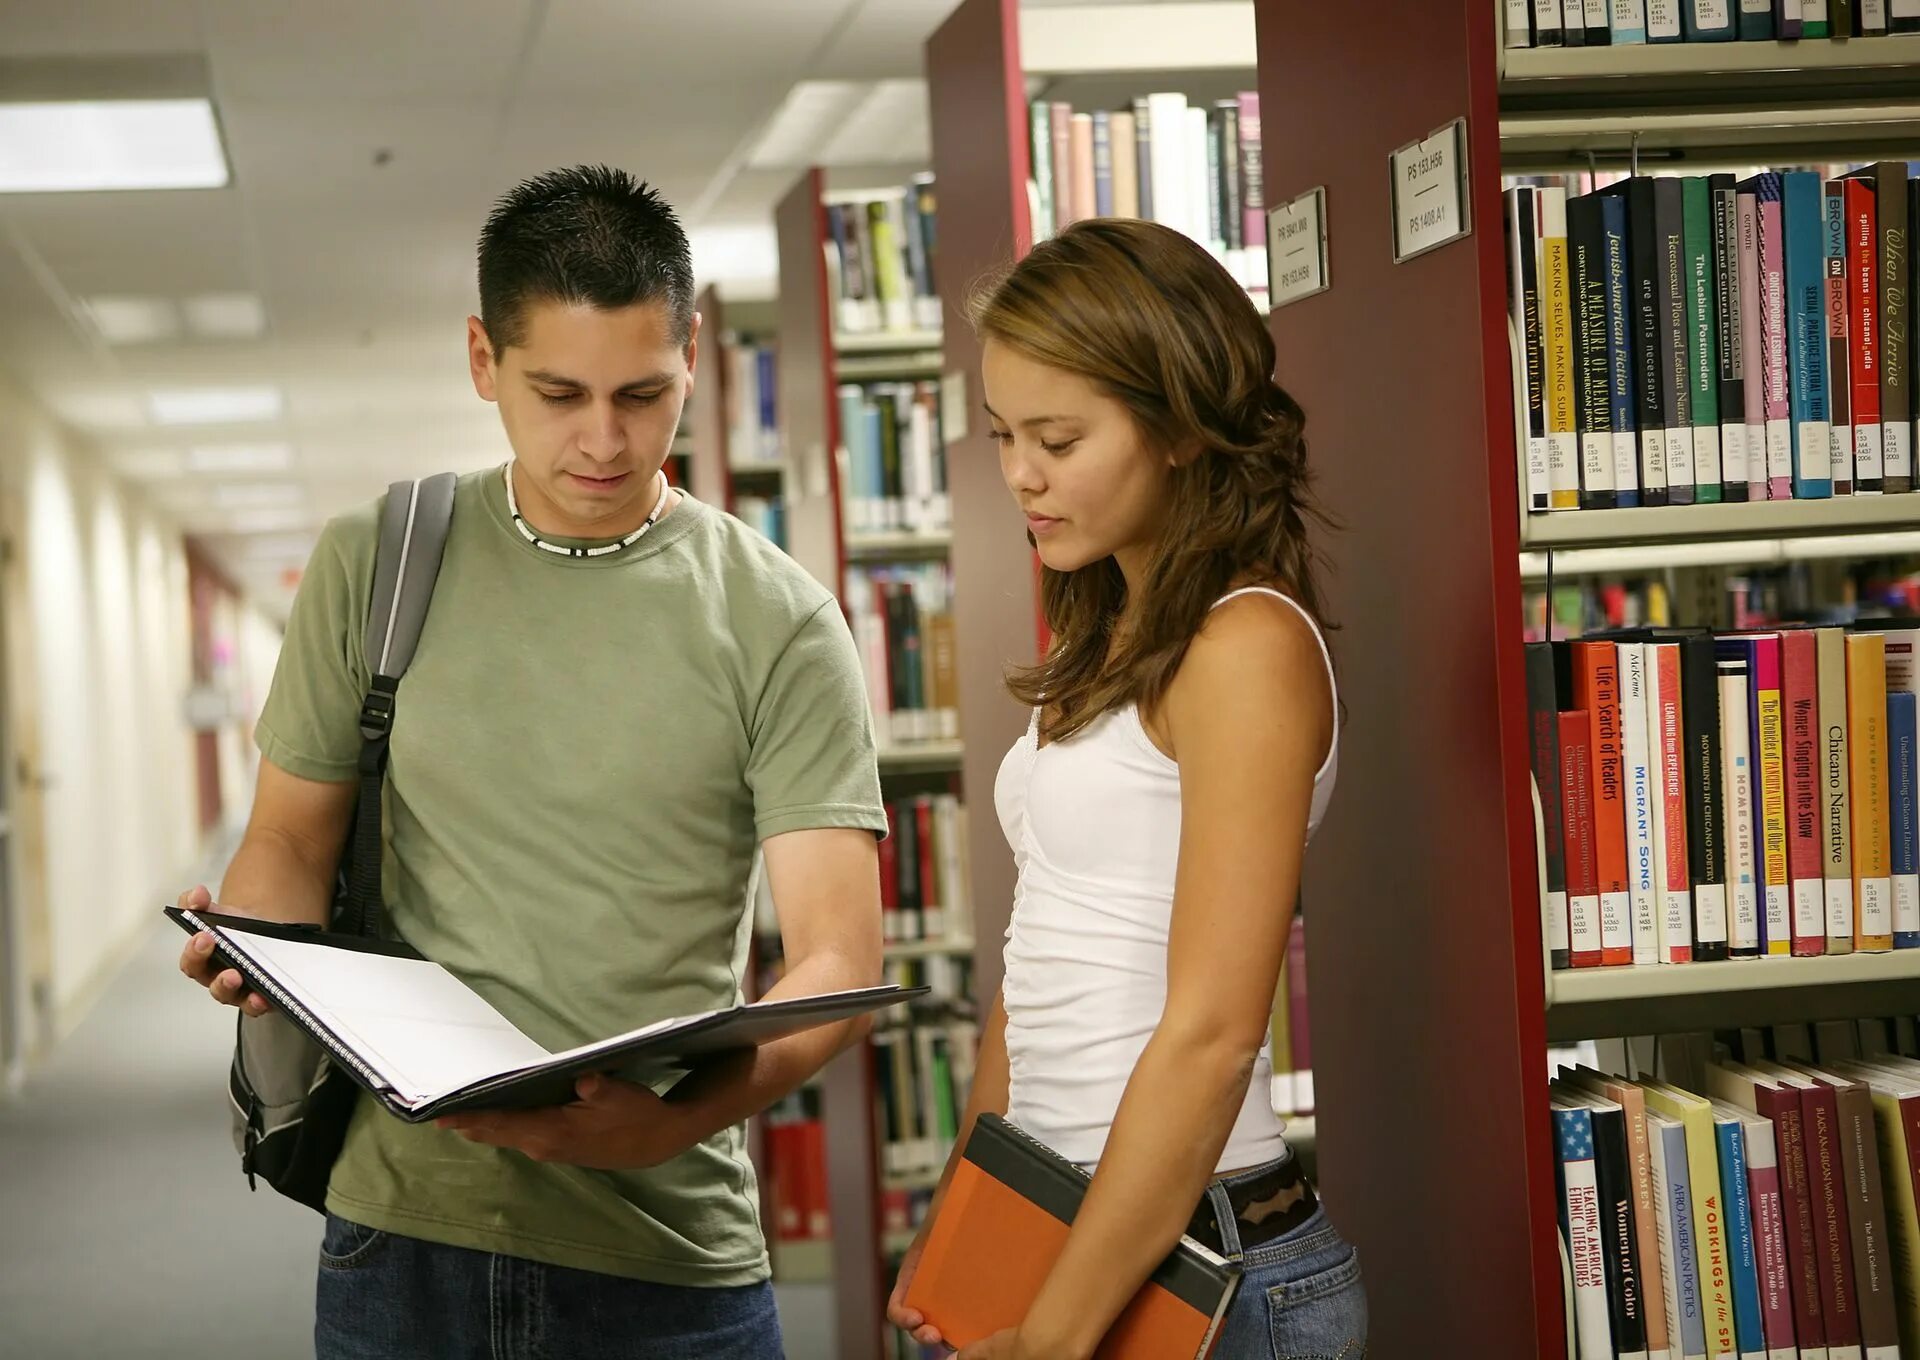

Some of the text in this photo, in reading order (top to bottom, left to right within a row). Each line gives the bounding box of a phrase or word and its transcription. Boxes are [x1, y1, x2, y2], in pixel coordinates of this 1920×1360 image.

[1408, 150, 1443, 181] PS 153.H56
[1410, 206, 1445, 234] PS 1408.A1
[1716, 200, 1725, 246] Literary
[1744, 214, 1752, 250] OUTWRITE
[1859, 214, 1870, 246] spilling
[1552, 245, 1562, 297] MASKING
[1578, 245, 1587, 299] STORYTELLING
[1667, 234, 1681, 298] Heterosexual
[1729, 243, 1738, 293] LESBIAN
[1829, 199, 1843, 335] BROWN ON BROWN
[1862, 249, 1871, 264] the
[1607, 232, 1625, 345] Jewish-American
[1720, 273, 1729, 317] Cultural
[1806, 286, 1817, 314] SEXUAL
[1862, 267, 1871, 292] beans
[1863, 297, 1872, 305] in
[1524, 289, 1537, 338] LEAVING
[1554, 302, 1564, 342] SELVES,
[1580, 301, 1588, 317] AND
[1588, 295, 1606, 351] MEASURE
[1671, 303, 1682, 326] Plots
[1695, 254, 1710, 391] The Lesbian Postmodern
[1886, 228, 1906, 386] When We Arrive
[1581, 320, 1589, 355] IDENTITY
[1643, 280, 1658, 410] are girls necessary?
[1673, 330, 1683, 347] and
[1721, 322, 1731, 369] Readings
[1731, 299, 1742, 369] CRITICISM
[1769, 272, 1783, 401] CONTEMPORARY LESBIAN WRITING
[1799, 340, 1807, 369] Cultural
[1527, 338, 1538, 376] LITTLE
[1555, 346, 1566, 392] MAKING
[1583, 358, 1589, 366] IN
[1592, 358, 1607, 373] OF
[1615, 349, 1627, 395] Fiction
[1674, 351, 1686, 388] Lesbian
[1809, 361, 1821, 392] TEXTUAL
[1584, 367, 1592, 406] AMERICAN
[1593, 378, 1611, 431] MEMORY
[1800, 371, 1808, 401] Criticism
[1630, 654, 1641, 697] McKenna
[1665, 702, 1678, 736] LEARNING
[1762, 699, 1778, 712] The
[1596, 666, 1618, 800] Life in Search of Readers
[1667, 737, 1678, 752] from
[1763, 715, 1780, 750] Chronicles
[1667, 754, 1679, 796] EXPERIENCE
[1765, 752, 1780, 760] of
[1792, 699, 1815, 838] Women Singing in the Snow
[1565, 745, 1578, 838] Chicana Literature
[1576, 745, 1588, 817] Understanding
[1765, 762, 1780, 794] PANCHITA
[1829, 725, 1844, 863] Chicano Narrative
[1868, 717, 1880, 871] CONTEMPORARY CHICANA
[1700, 735, 1714, 882] MOVEMENTS IN CHICANO POETRY
[1736, 774, 1749, 867] HOME GIRLS
[1766, 796, 1782, 816] VILLA
[1767, 818, 1782, 830] and
[1899, 736, 1912, 871] Understanding Chicano Literature
[1634, 766, 1650, 890] MIGRANT SONG
[1767, 833, 1783, 852] Other
[1815, 1107, 1826, 1133] BLACK
[1633, 1113, 1650, 1210] THE WOMEN
[1818, 1135, 1831, 1180] AMERICAN
[1730, 1133, 1750, 1267] BLACK AMERICAN WOMEN'S WRITING
[1823, 1182, 1835, 1218] WOMEN
[1569, 1187, 1589, 1287] ETHNIC LITERATURES
[1583, 1185, 1602, 1287] TEACHING AMERICAN
[1705, 1196, 1724, 1287] WORKINGS
[1770, 1192, 1786, 1289] BLACK AMERICAN POETS
[1864, 1222, 1873, 1235] The
[1866, 1236, 1875, 1254] Black
[1616, 1200, 1637, 1319] Women of Color
[1673, 1183, 1696, 1318] AFRO-AMERICAN POETICS
[1759, 1193, 1778, 1310] BETWEEN WORLDS, 1940-1960
[1830, 1243, 1841, 1262] AND
[1714, 1293, 1726, 1304] of
[1717, 1307, 1729, 1321] the
